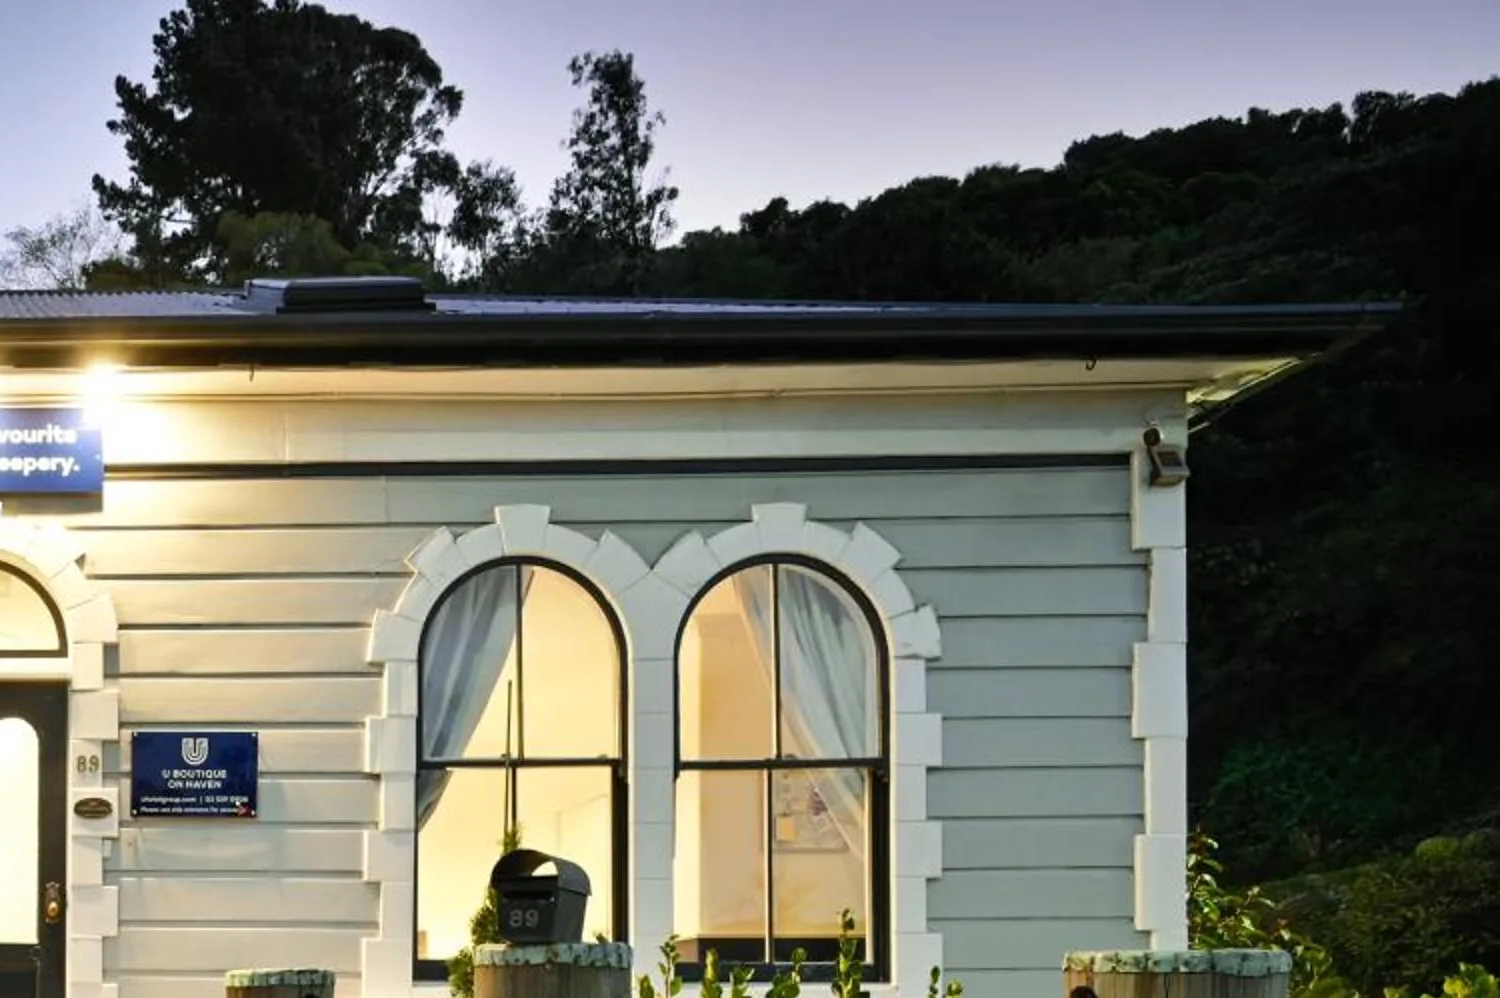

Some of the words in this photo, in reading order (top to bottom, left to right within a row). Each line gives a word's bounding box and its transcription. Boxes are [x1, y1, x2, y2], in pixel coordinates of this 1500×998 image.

[77, 755, 100, 773] 89
[161, 769, 171, 779] U
[173, 769, 227, 779] BOUTIQUE
[167, 780, 183, 789] ON
[185, 780, 222, 789] HAVEN
[509, 909, 539, 928] 89
